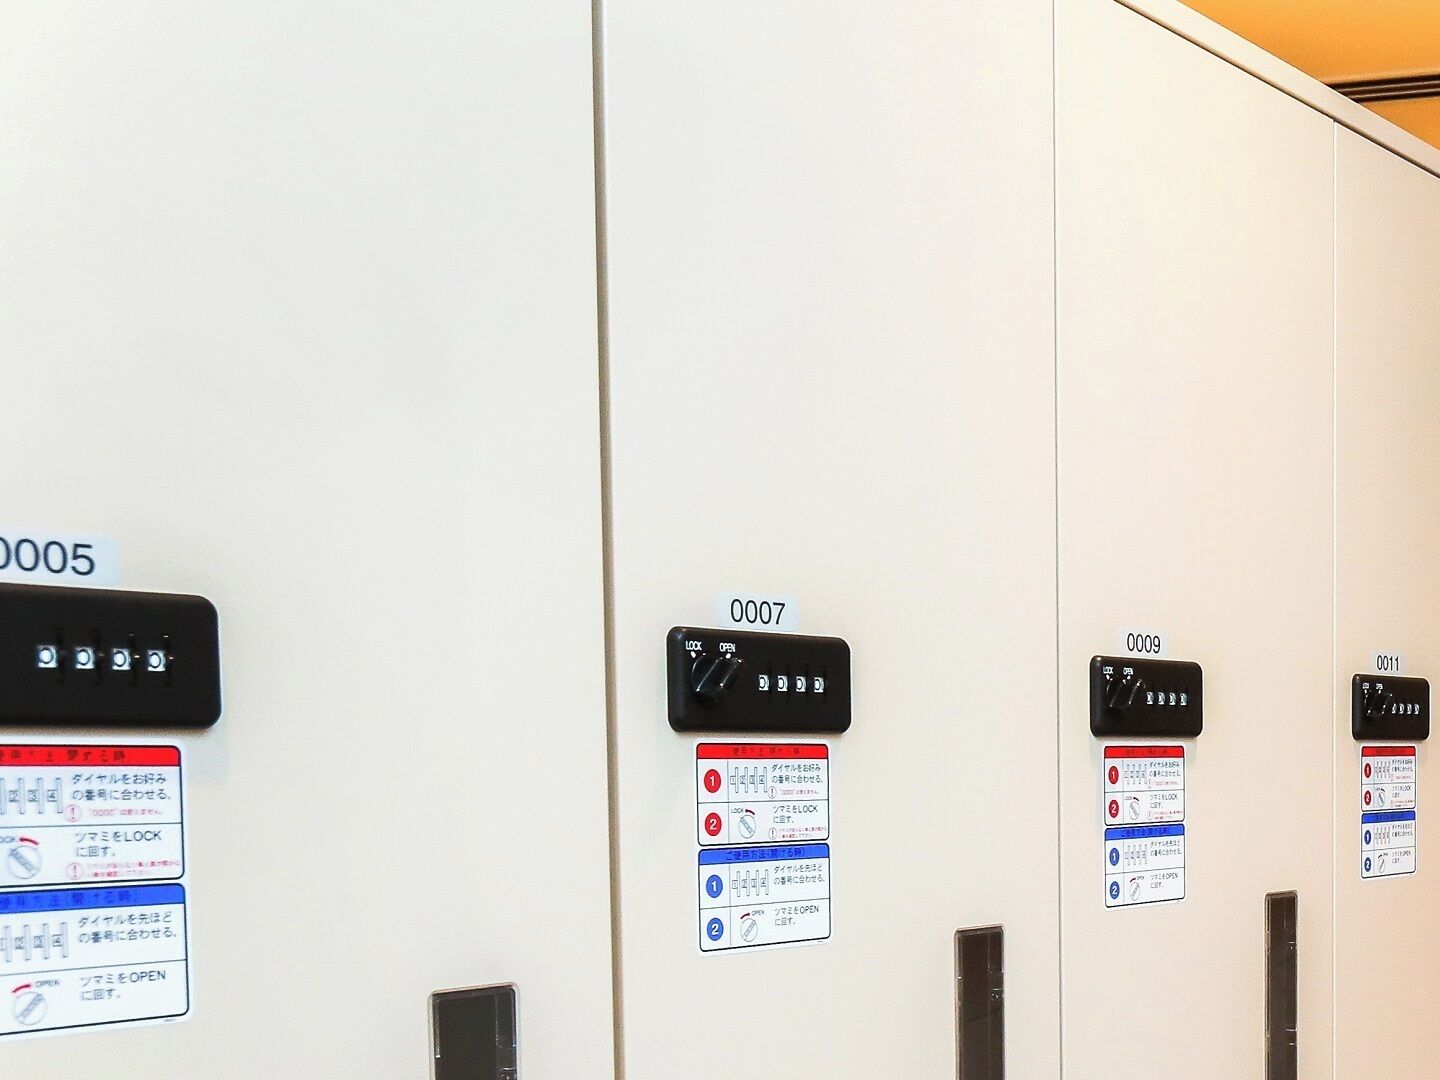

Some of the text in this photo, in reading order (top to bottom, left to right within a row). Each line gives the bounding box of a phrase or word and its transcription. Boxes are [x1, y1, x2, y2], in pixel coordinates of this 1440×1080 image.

[730, 598, 786, 626] 0007
[685, 641, 702, 651] LOCK
[719, 642, 736, 653] OPEN
[1126, 632, 1161, 654] 0009
[1376, 654, 1399, 671] 0011
[72, 773, 167, 785] ダイヤルをお好み
[79, 911, 173, 928] ダイヤルを先ほど
